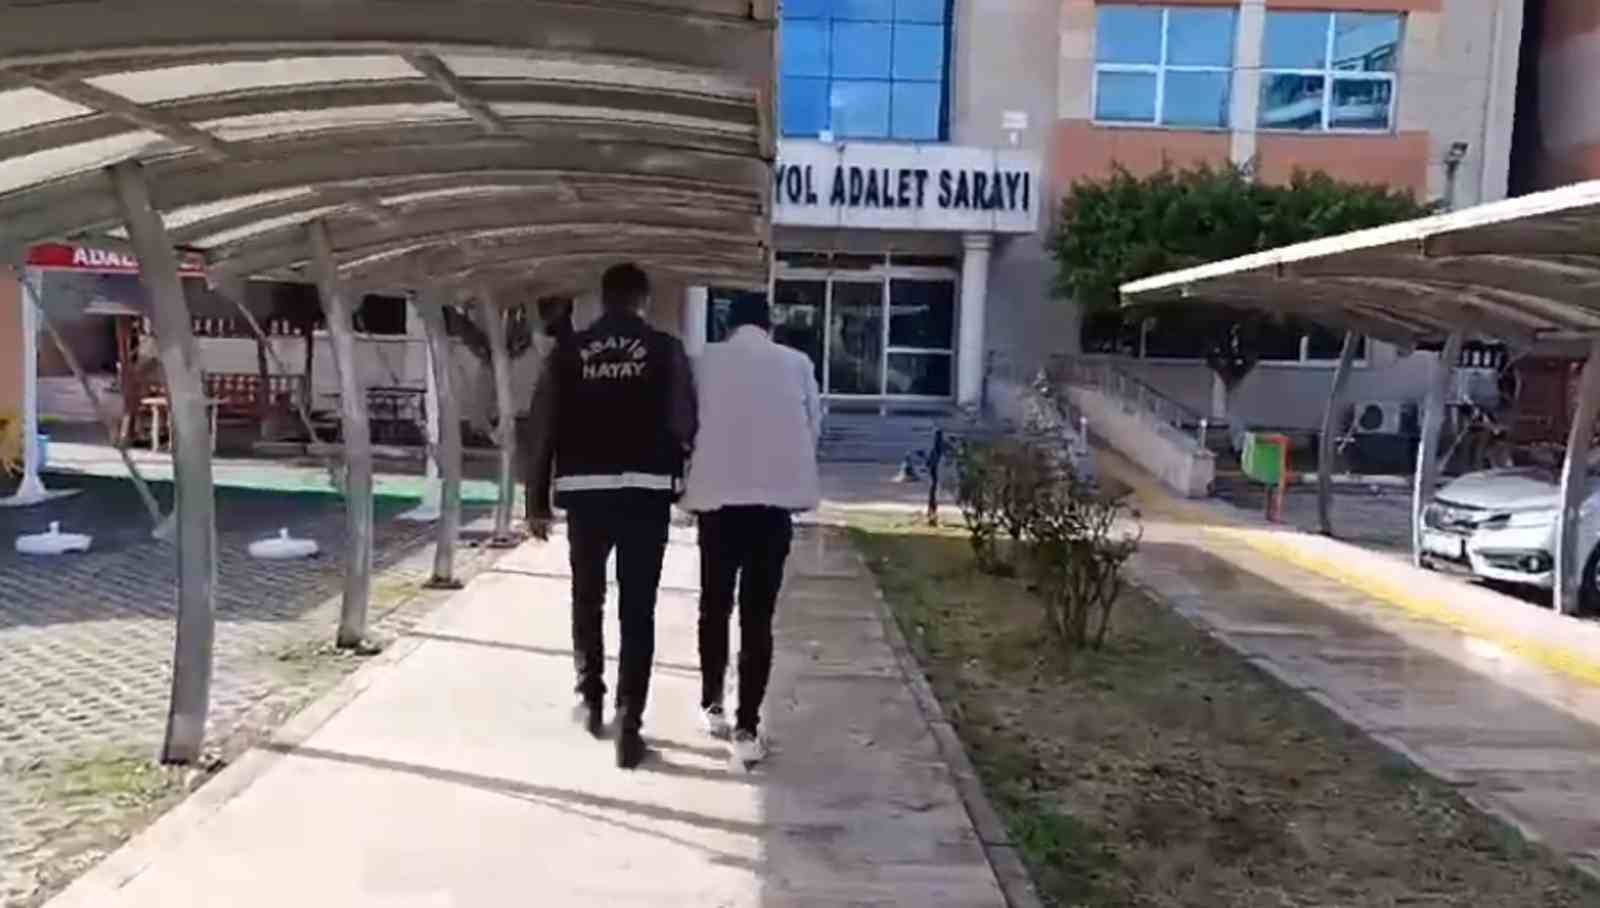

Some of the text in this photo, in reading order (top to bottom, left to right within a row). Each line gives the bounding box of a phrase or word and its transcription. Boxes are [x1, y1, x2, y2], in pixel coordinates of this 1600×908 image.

[830, 165, 928, 208] ADALET
[938, 168, 1030, 211] SARAYI
[582, 361, 647, 379] HATAY
